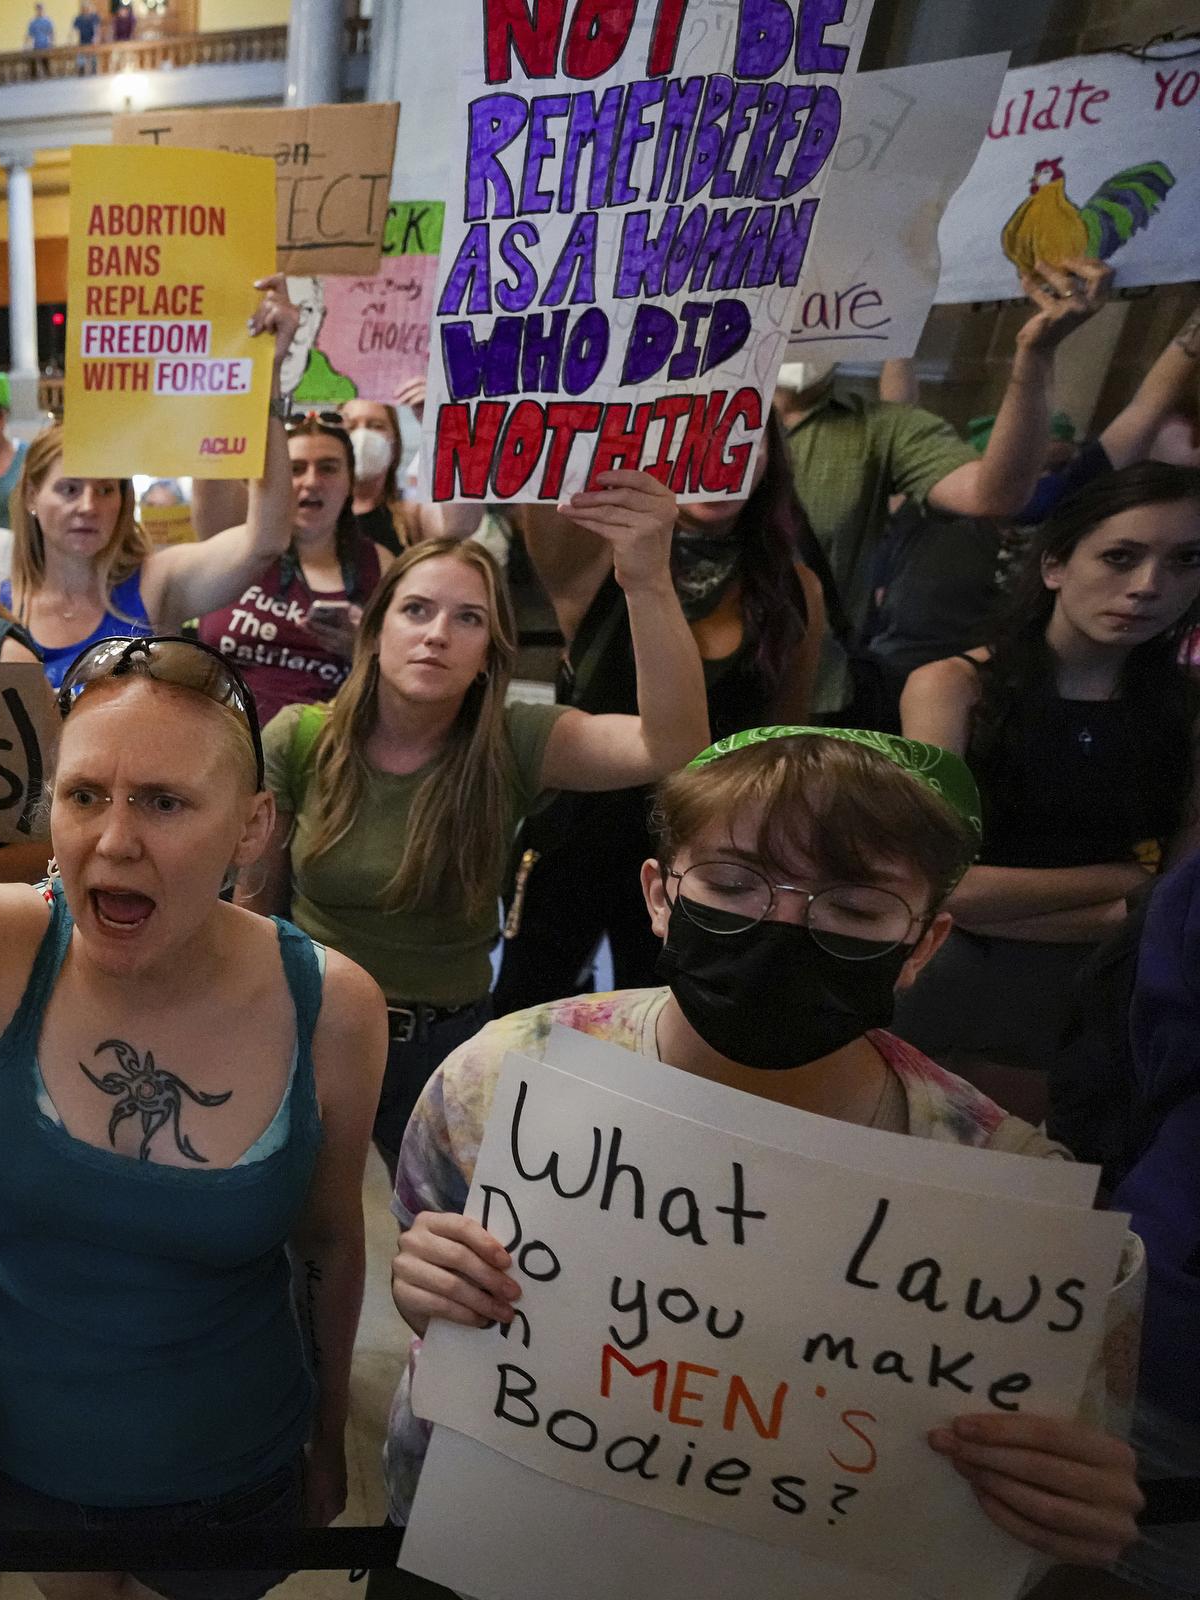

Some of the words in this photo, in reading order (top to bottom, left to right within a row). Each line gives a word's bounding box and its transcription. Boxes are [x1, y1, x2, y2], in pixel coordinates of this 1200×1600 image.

[464, 74, 842, 223] REMEMBERED
[88, 204, 226, 237] ABORTION
[87, 245, 161, 277] BANS
[437, 221, 540, 315] AS
[538, 212, 599, 306] A
[612, 198, 820, 299] WOMAN
[86, 285, 205, 317] REPLACE
[85, 324, 207, 355] FREEDOM
[441, 307, 611, 400] WHO
[619, 298, 752, 388] DID
[83, 362, 149, 391] WITH
[157, 362, 246, 391] FORCE.
[200, 437, 246, 455] ACLU
[432, 387, 763, 503] NOTHING
[228, 608, 278, 641] The
[239, 585, 306, 626] Fuck
[511, 1081, 766, 1245] What
[846, 1198, 1086, 1332] Laws
[480, 1184, 561, 1282] Do
[610, 1276, 744, 1350] you
[802, 1332, 1033, 1412] make
[601, 1343, 878, 1474] MEN'S
[494, 1363, 859, 1526] Bodies?
